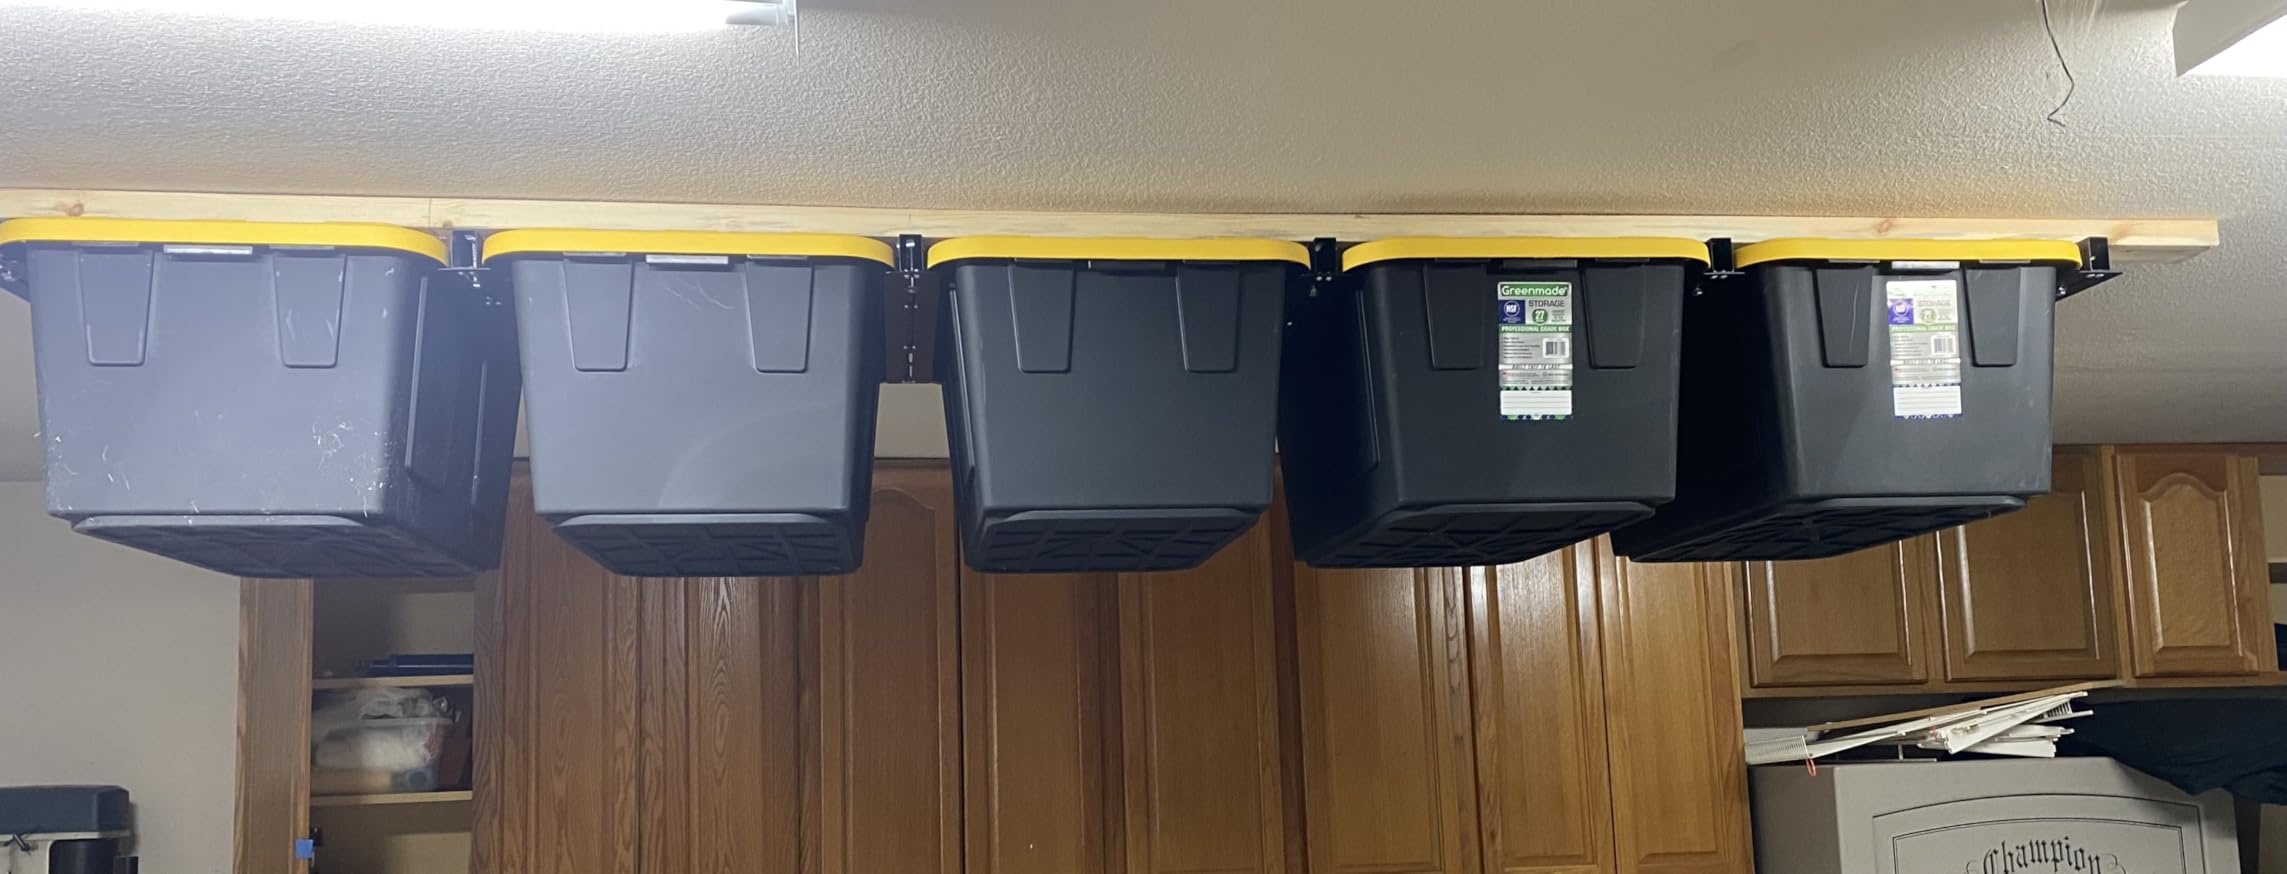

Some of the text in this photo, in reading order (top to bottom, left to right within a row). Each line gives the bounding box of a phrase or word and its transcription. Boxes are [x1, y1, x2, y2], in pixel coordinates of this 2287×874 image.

[1501, 285, 1566, 296] Greenmade
[1505, 304, 1518, 313] NSF
[1528, 300, 1566, 308] STORAGE
[1535, 310, 1545, 320] 27
[1983, 836, 2100, 874] Champion
